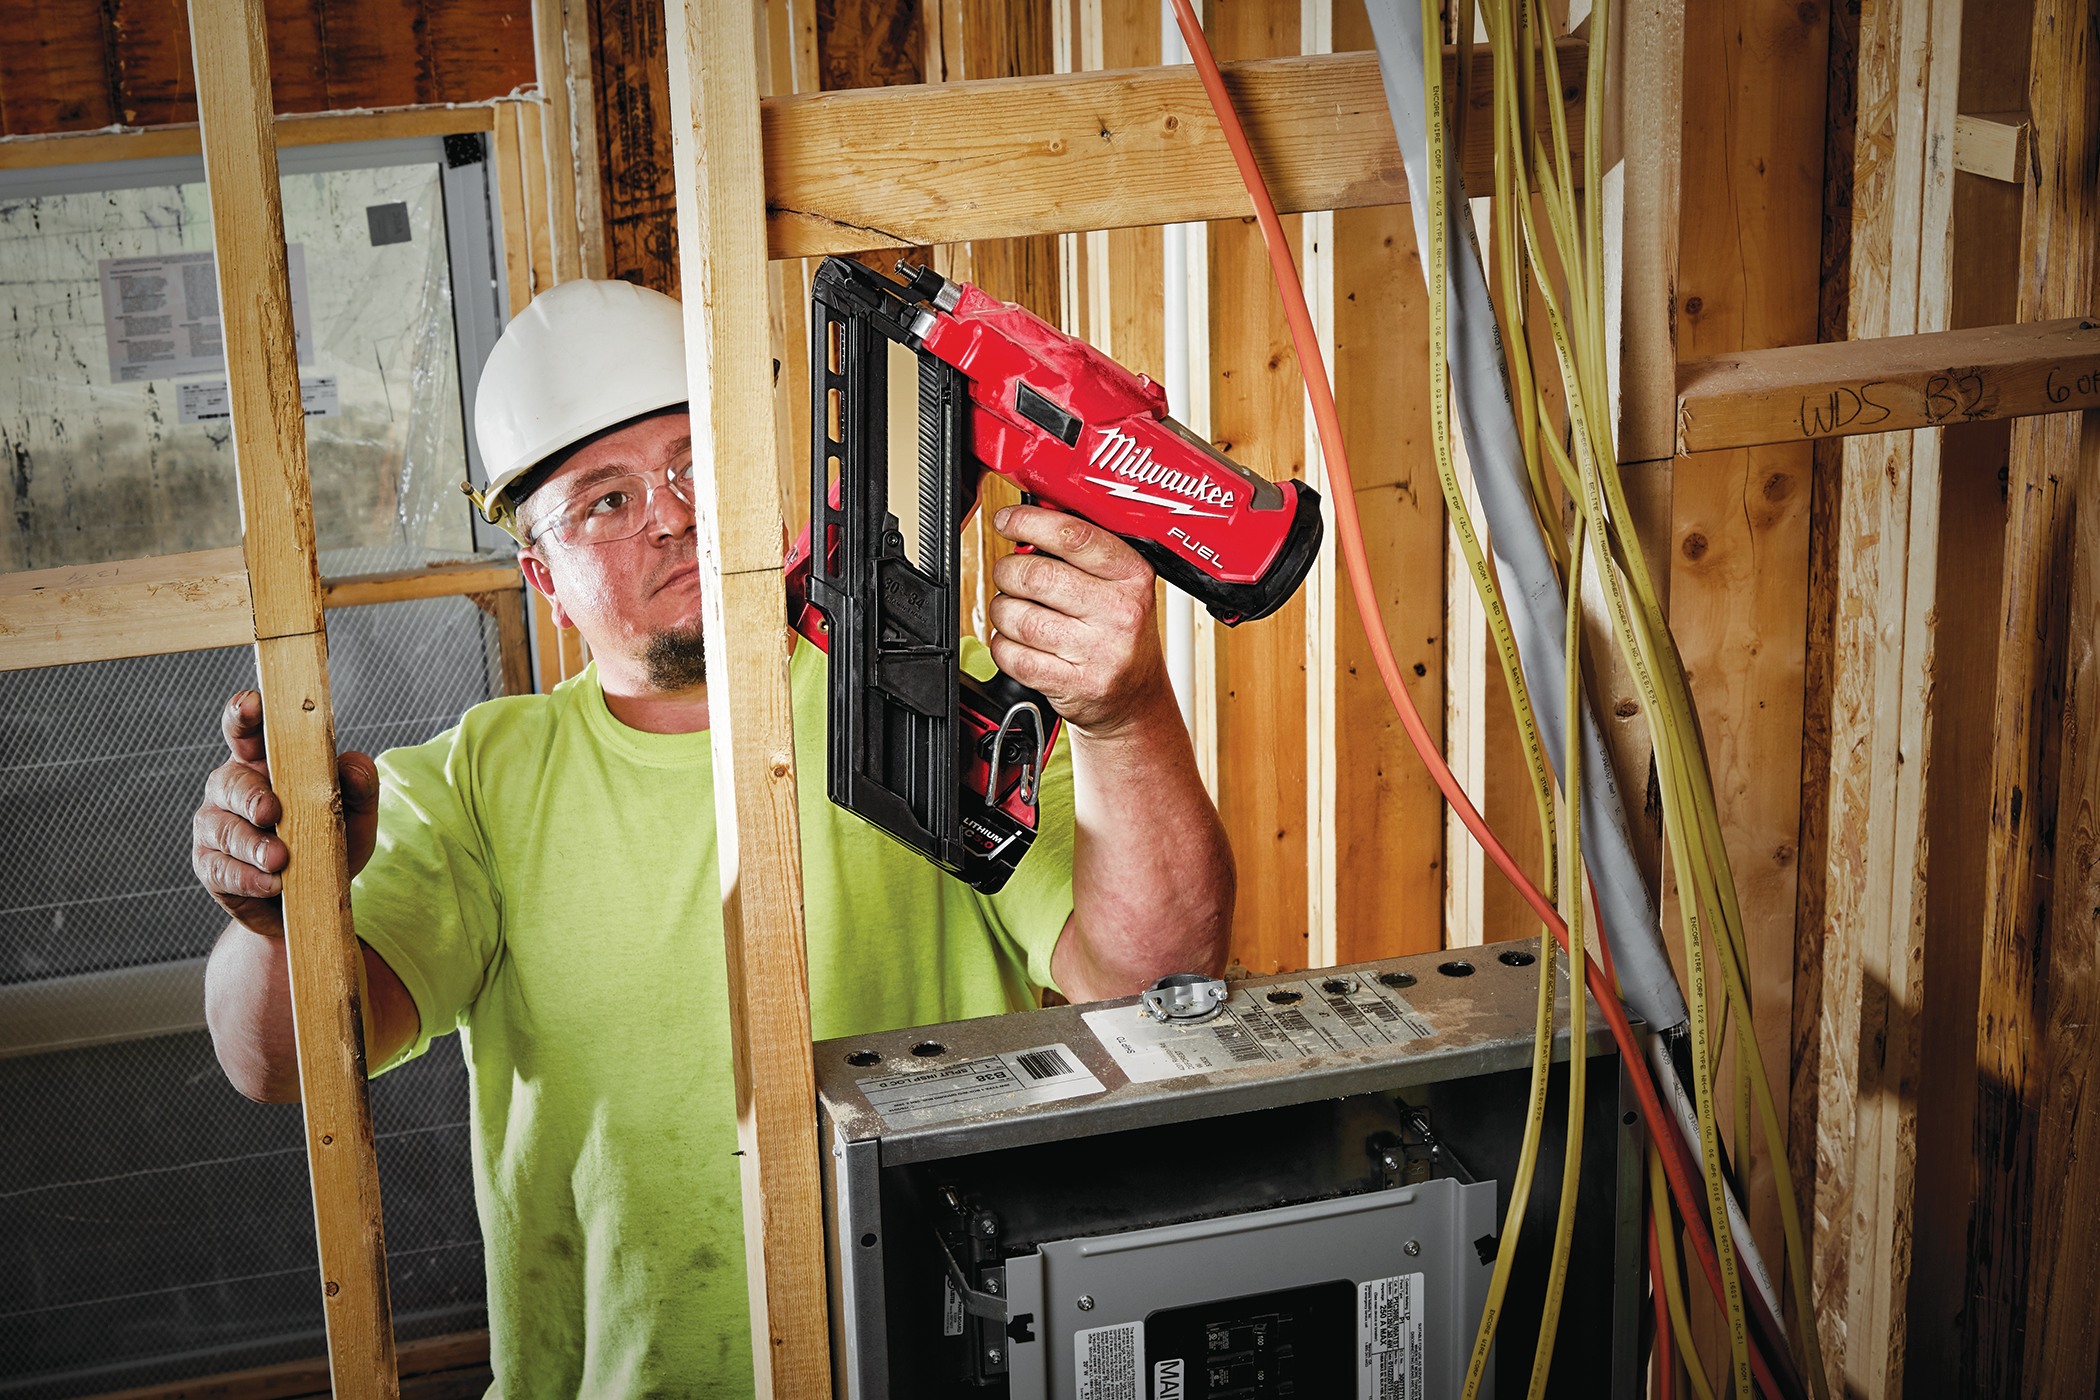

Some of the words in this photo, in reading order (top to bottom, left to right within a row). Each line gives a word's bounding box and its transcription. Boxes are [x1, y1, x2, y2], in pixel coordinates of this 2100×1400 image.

[1801, 381, 1890, 436] WDS
[1089, 427, 1234, 508] Milwaukee
[1549, 308, 1556, 318] DR
[1555, 331, 1563, 341] UT
[1559, 345, 1570, 369] OTHER
[1595, 518, 1603, 535] (TM)
[1599, 540, 1619, 598] MANUFACTURED
[1615, 601, 1627, 626] UNDER
[1625, 629, 1633, 646] PAT.
[1167, 526, 1223, 569] FUEL
[1476, 561, 1488, 581] ROOM
[1485, 584, 1493, 594] ID
[1491, 601, 1500, 616] BED
[1511, 667, 1521, 686] BATH
[1528, 732, 1535, 742] FR
[1531, 744, 1538, 755] DR
[1540, 777, 1549, 798] OTHER
[963, 817, 1003, 844] LITHIUM
[1690, 917, 1698, 947] ENCORE
[1545, 957, 1555, 1012] MANUFACTURED
[1115, 1036, 1129, 1044] TO
[1120, 1043, 1136, 1053] SHIP
[911, 1073, 937, 1081] INSP
[937, 1067, 968, 1077] SPLIT
[973, 1071, 1007, 1082] B38
[888, 1078, 911, 1086] LOC
[1702, 1099, 1710, 1119] 600V
[1705, 1126, 1713, 1143] (UL)
[1708, 1149, 1714, 1158] 06
[1160, 1361, 1179, 1400] MAI
[1740, 1362, 1748, 1381] ROOM
[1743, 1385, 1749, 1394] ID
